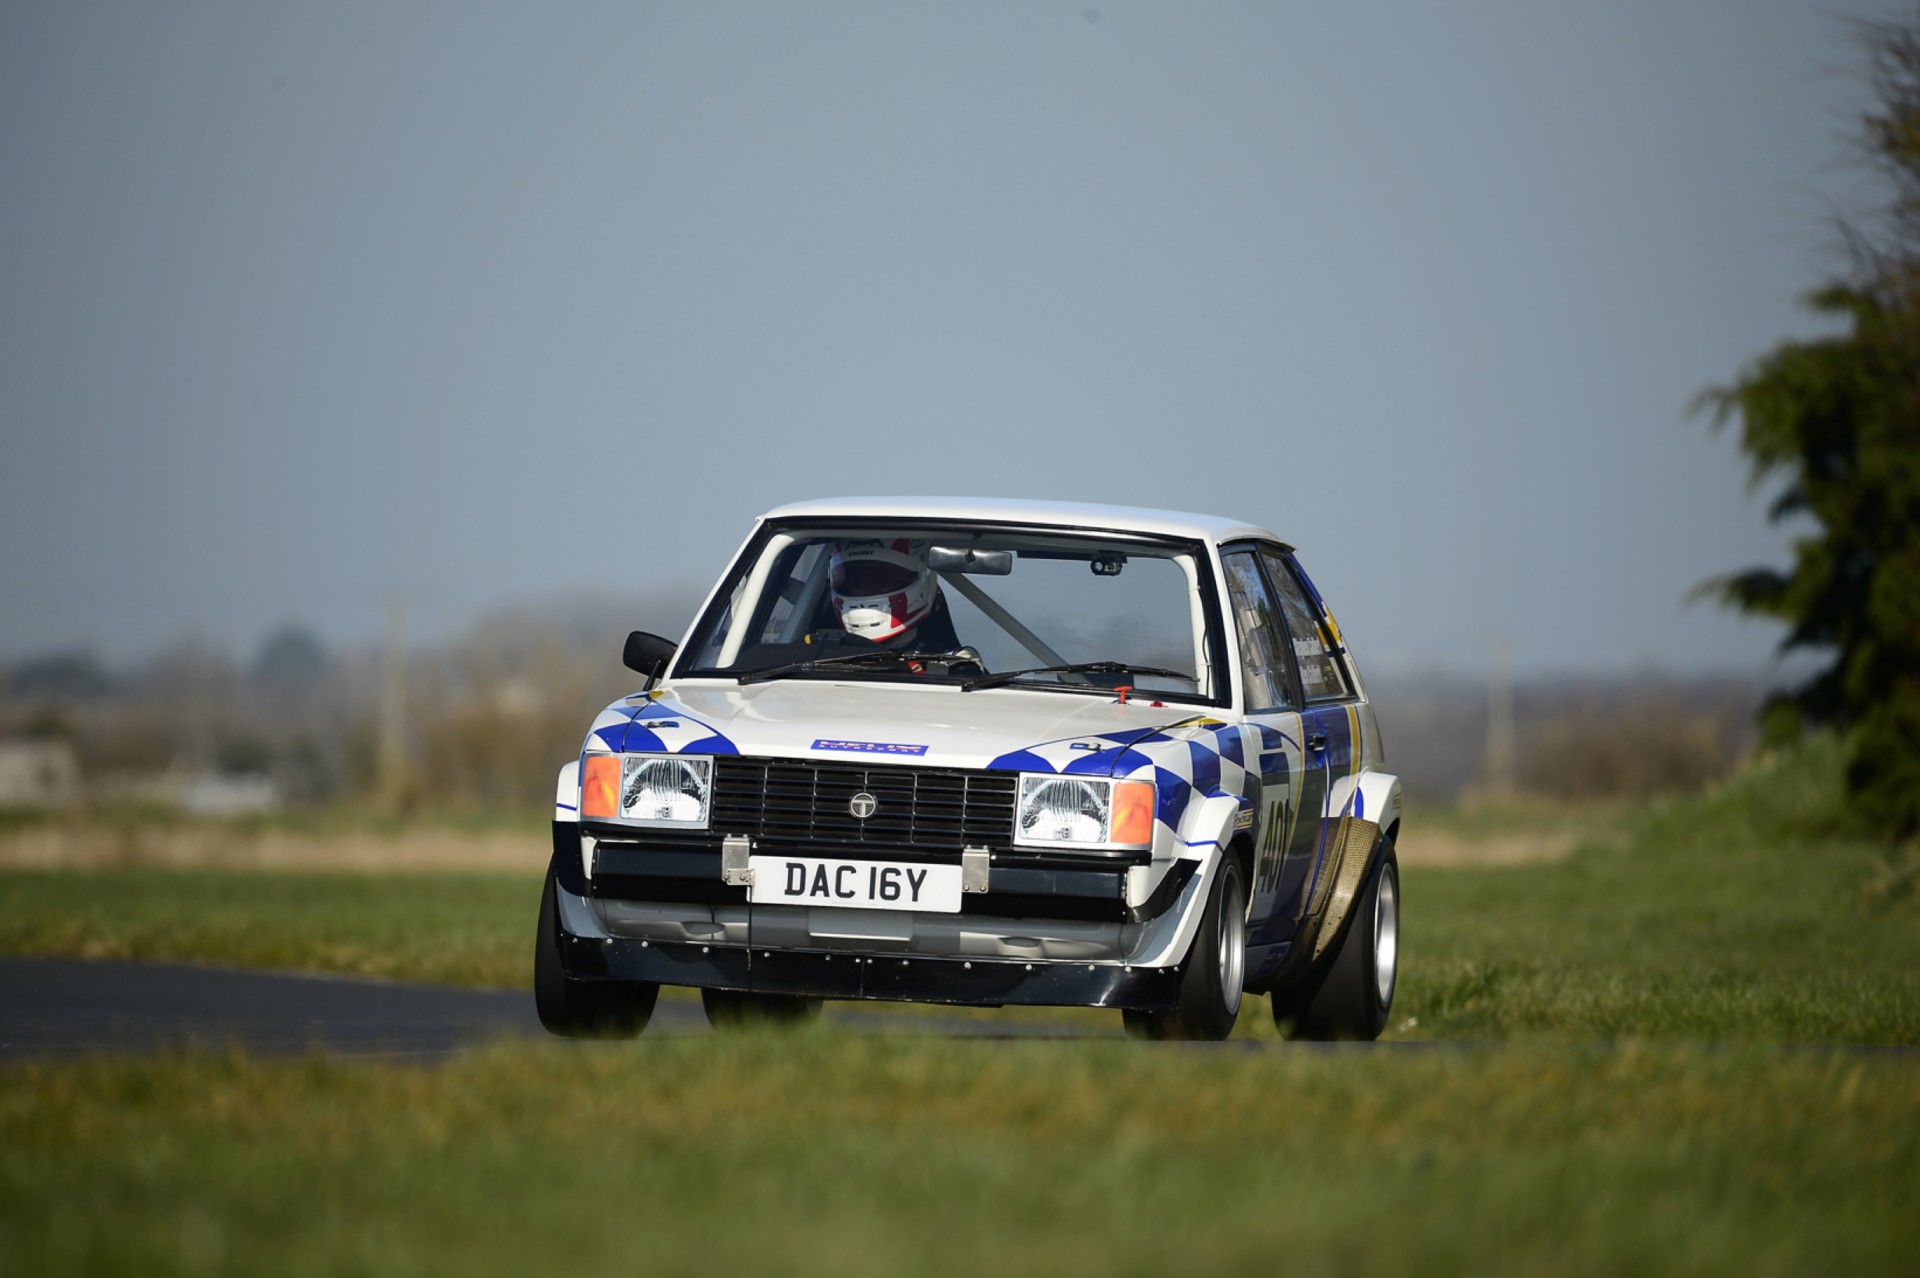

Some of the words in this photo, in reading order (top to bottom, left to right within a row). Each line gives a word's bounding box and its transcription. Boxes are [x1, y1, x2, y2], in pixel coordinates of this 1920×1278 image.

[818, 744, 920, 753] AUTOSPORT
[784, 862, 856, 899] DAC
[868, 866, 928, 902] 16Y
